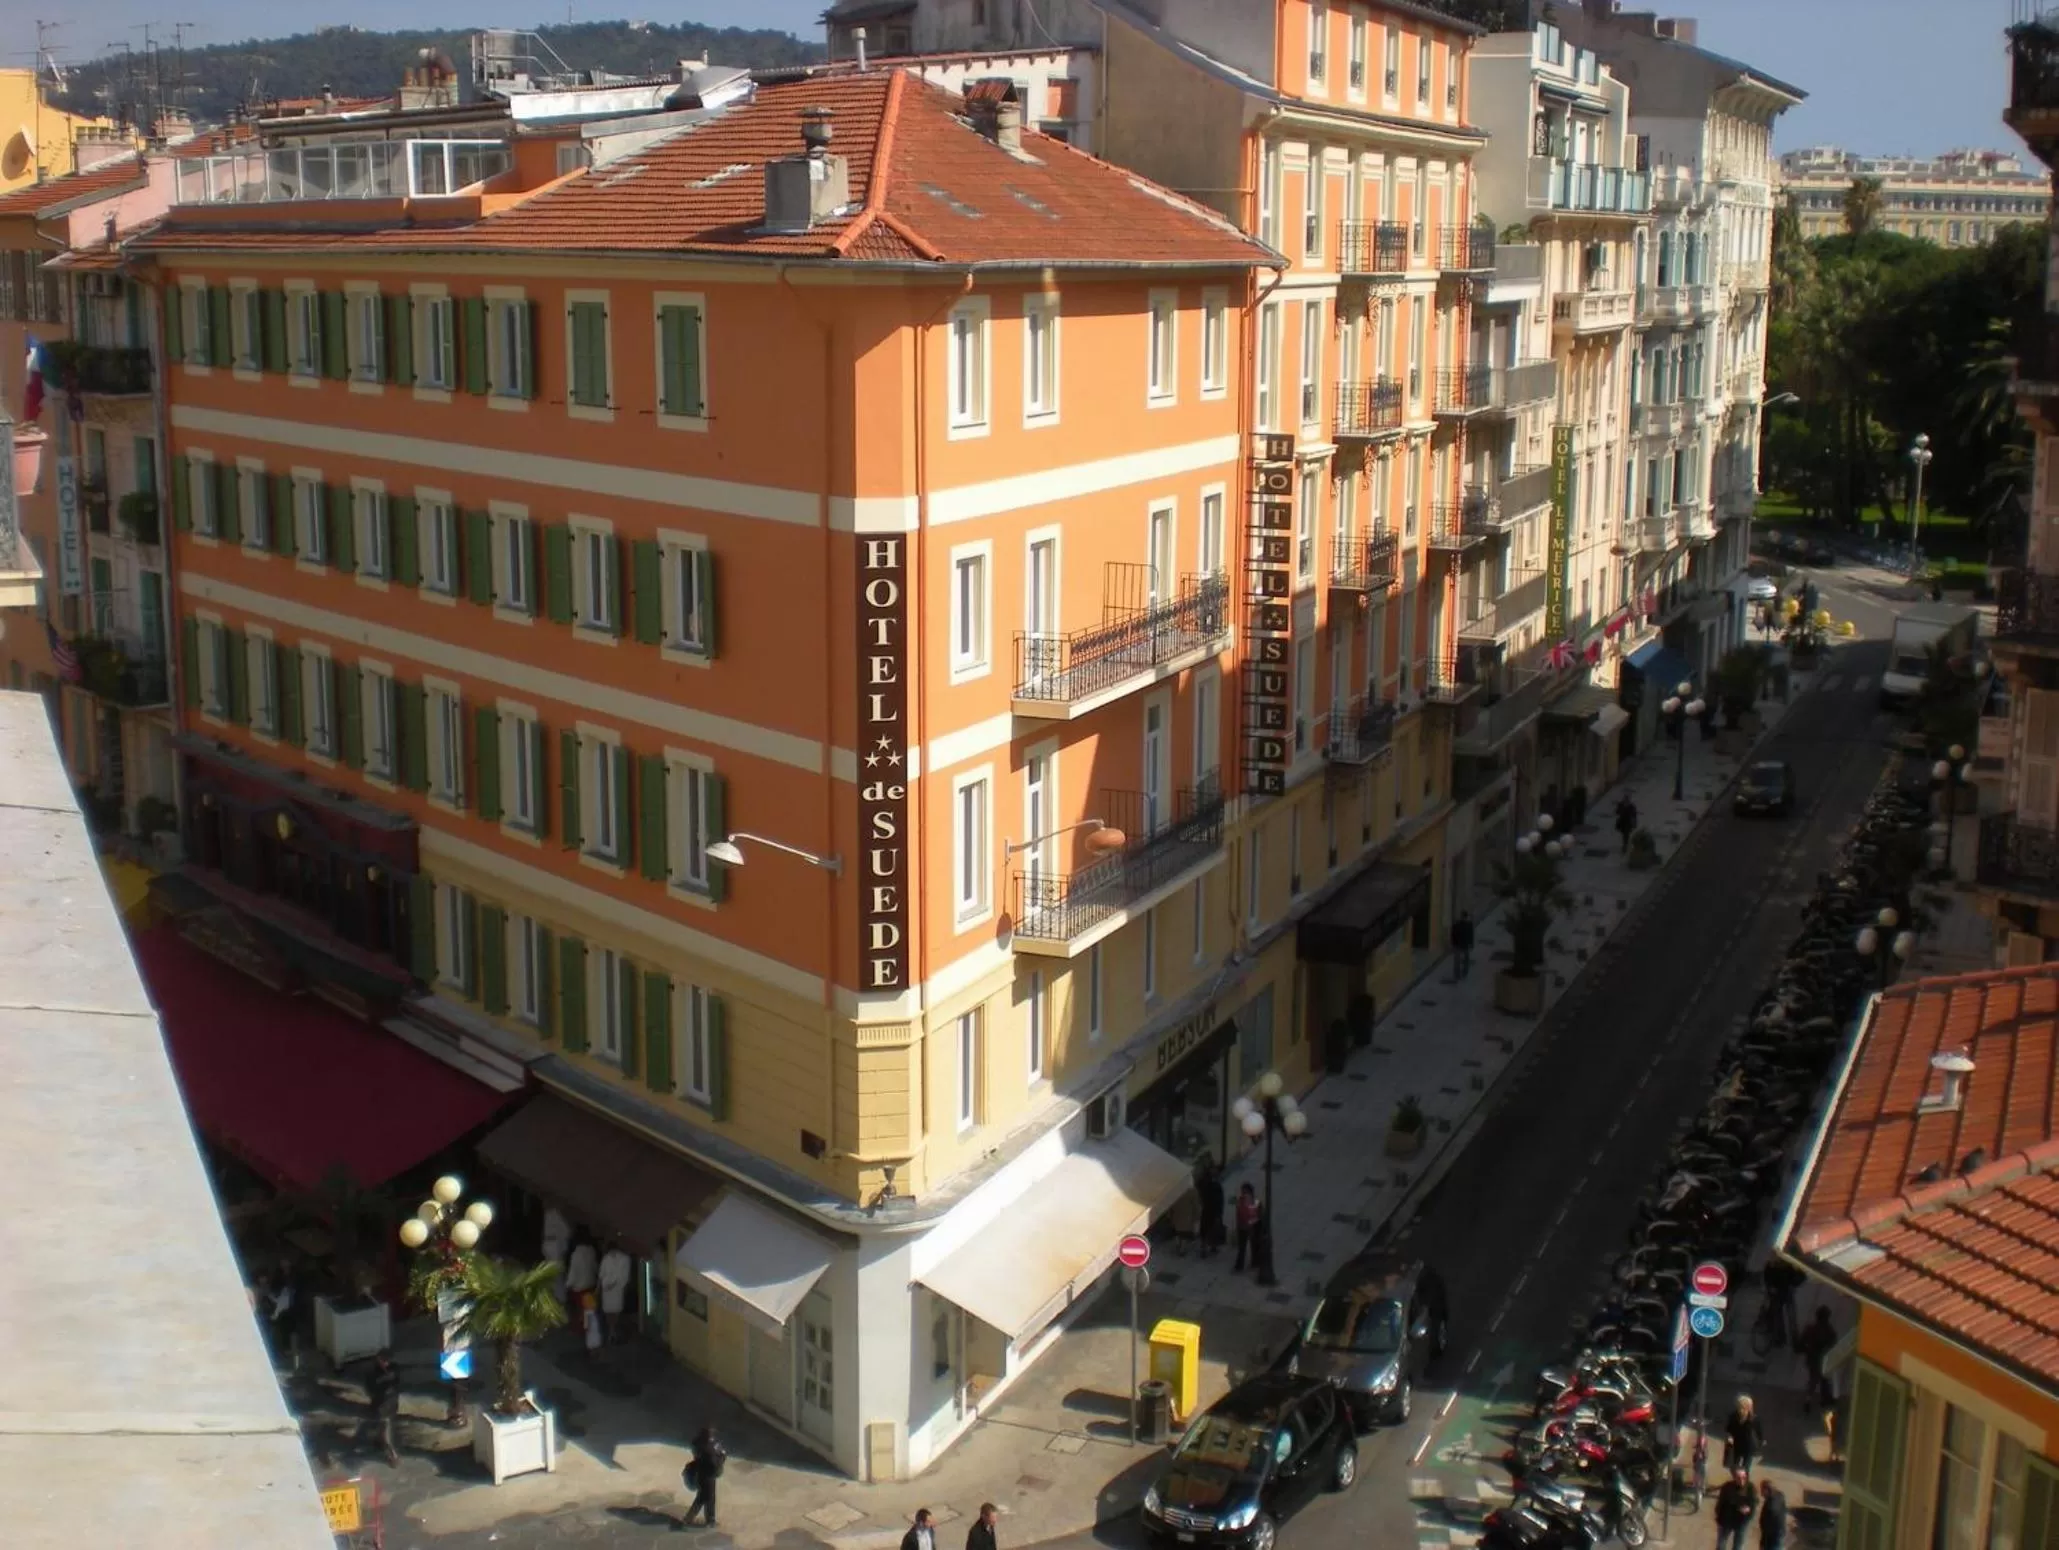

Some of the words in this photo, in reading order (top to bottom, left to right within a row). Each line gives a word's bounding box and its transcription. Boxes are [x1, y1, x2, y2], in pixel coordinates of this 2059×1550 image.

[1267, 439, 1288, 592] HOTEL
[1557, 429, 1568, 495] HOTEL
[60, 464, 77, 573] HOTEL
[1556, 505, 1564, 529] LE
[864, 540, 899, 723] HOTEL
[1552, 539, 1565, 629] MEURICE
[1264, 642, 1283, 791] SUEDE
[862, 781, 905, 801] de
[870, 811, 900, 987] SUEDE
